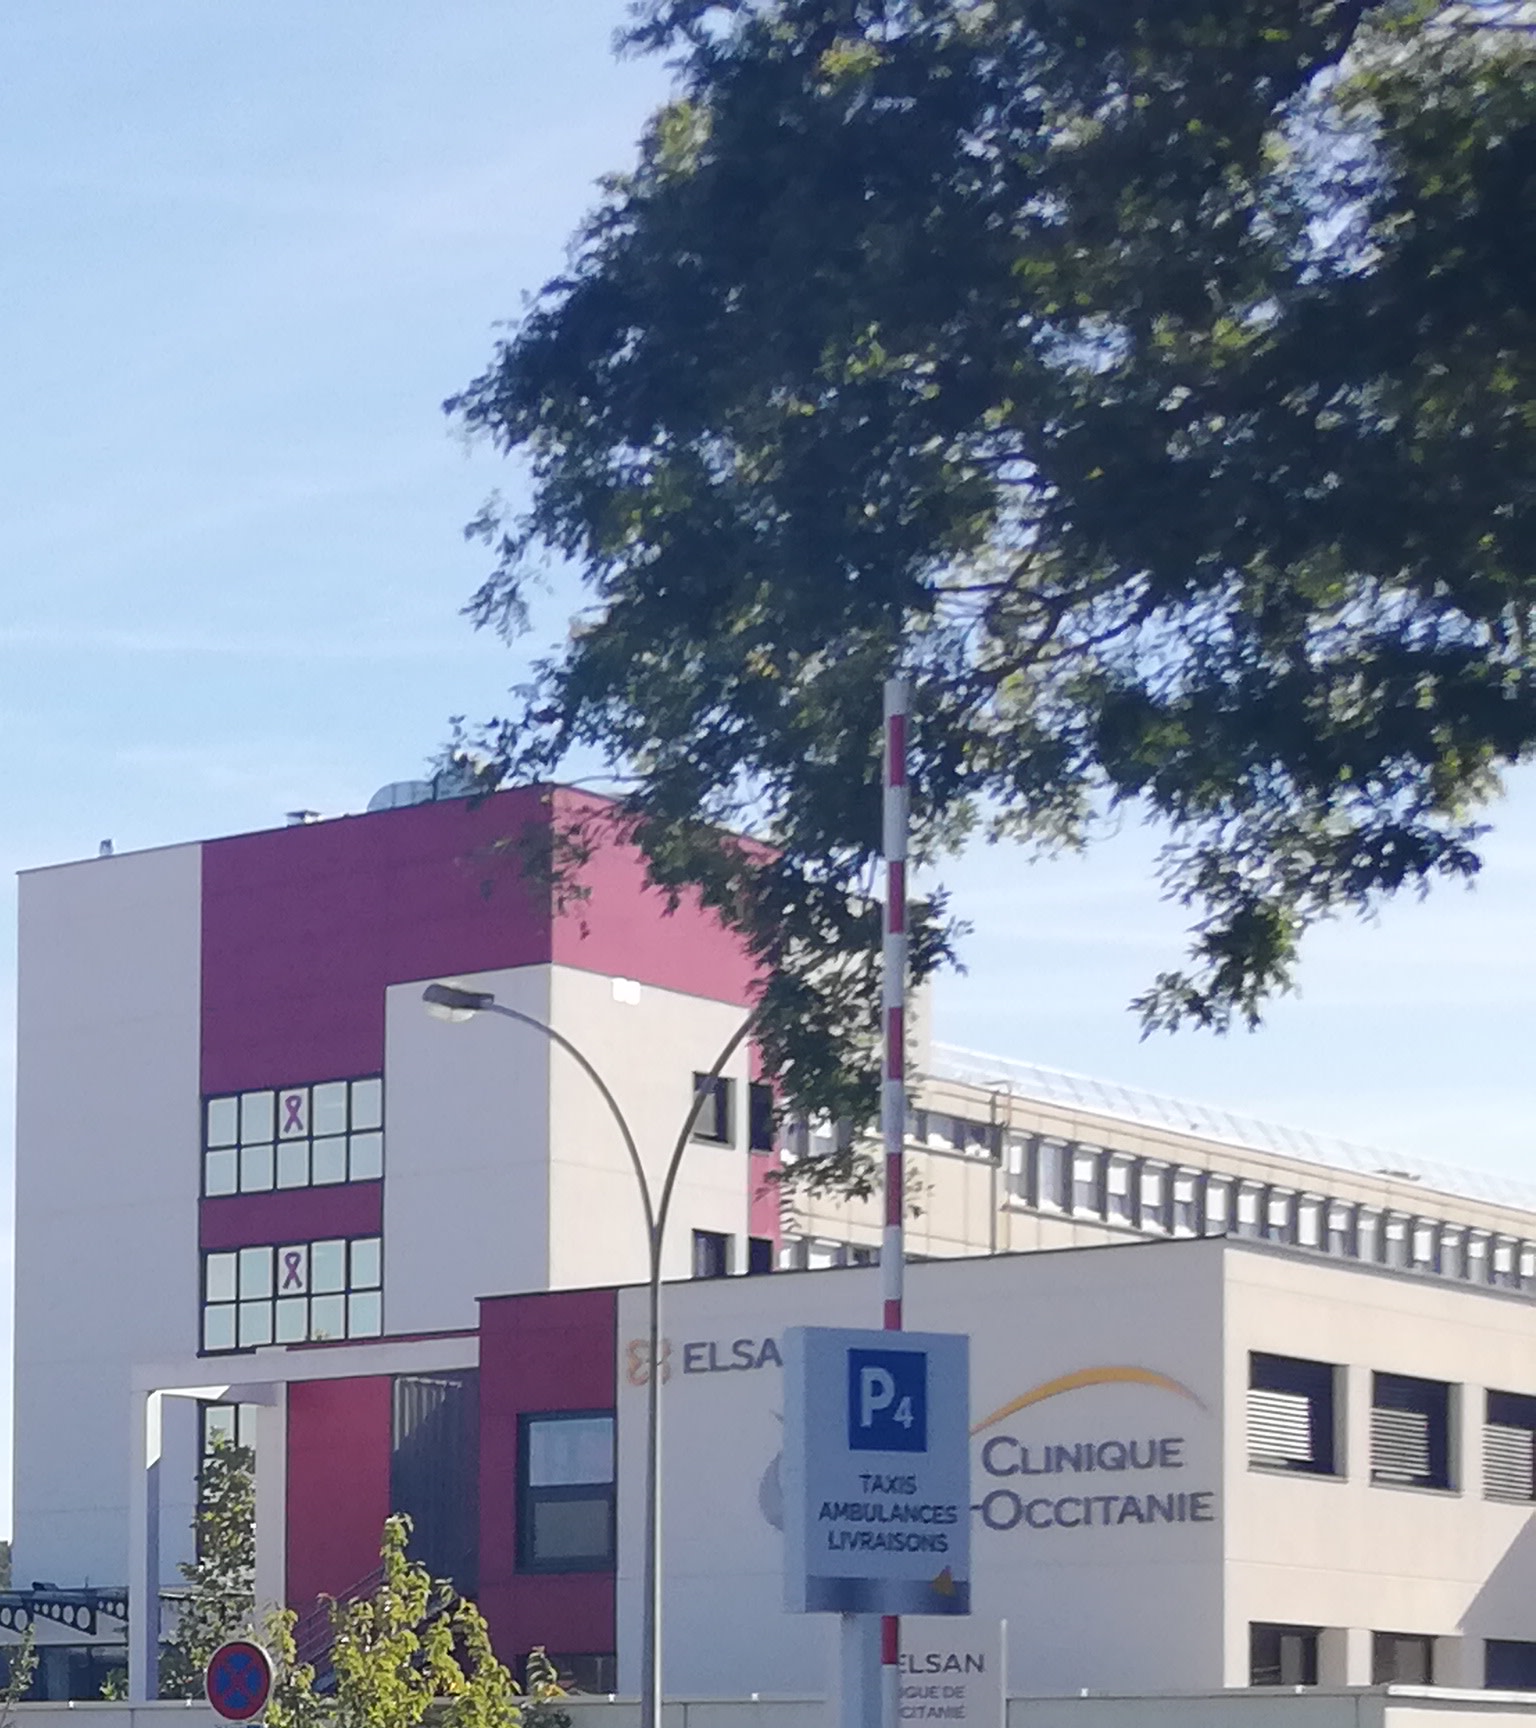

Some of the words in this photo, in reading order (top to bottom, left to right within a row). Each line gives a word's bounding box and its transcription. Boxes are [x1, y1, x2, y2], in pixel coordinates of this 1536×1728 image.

[683, 1338, 784, 1374] ELSA
[981, 1435, 1185, 1477] CLINIQUE
[859, 1473, 918, 1495] TAXIS
[818, 1501, 959, 1524] AMBULANCES
[981, 1489, 1216, 1531] OCCITANIE
[828, 1530, 949, 1553] LIVRAISONS
[900, 1686, 940, 1699] QUE
[943, 1686, 966, 1699] DE
[898, 1705, 966, 1719] CITANIE
